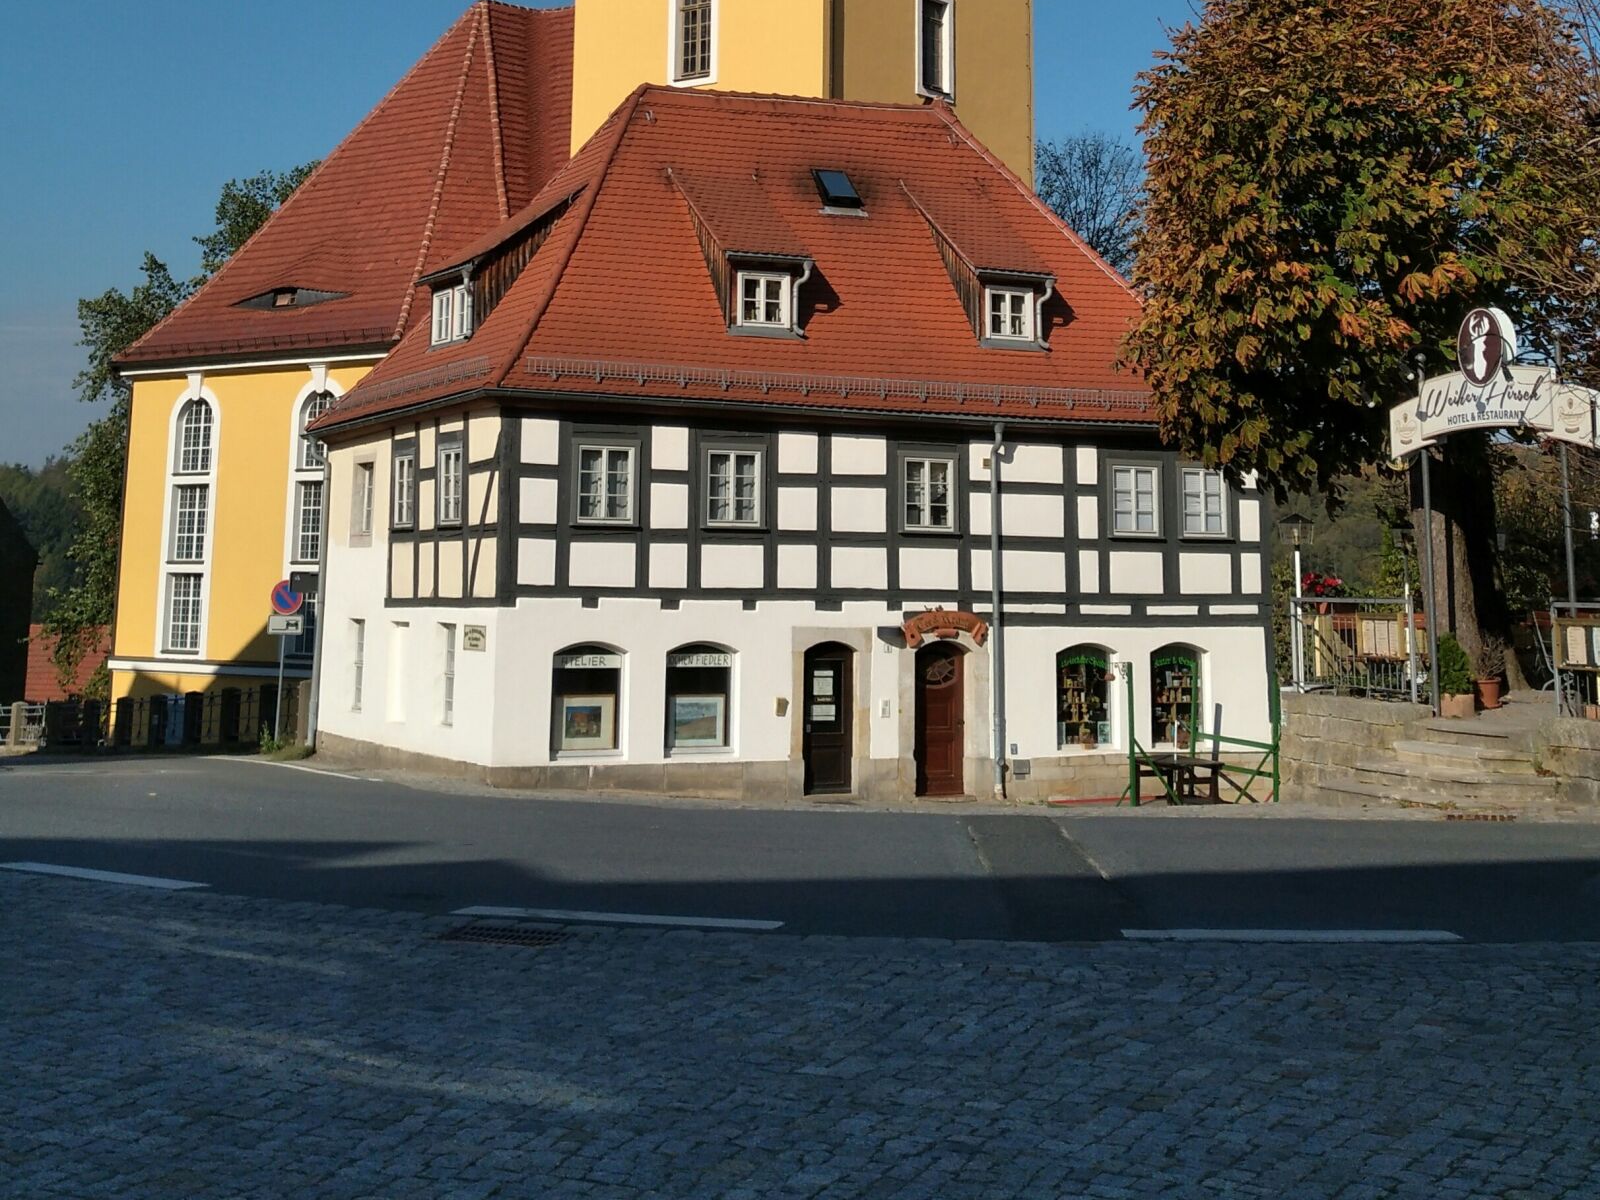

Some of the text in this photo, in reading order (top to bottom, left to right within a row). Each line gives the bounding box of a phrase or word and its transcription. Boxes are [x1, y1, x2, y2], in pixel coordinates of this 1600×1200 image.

[1485, 375, 1542, 409] Hirsch
[1447, 410, 1524, 426] HOTEL & RESTAURANT
[561, 656, 606, 667] ATELIER
[668, 655, 729, 666] OCHEN FIEDLER
